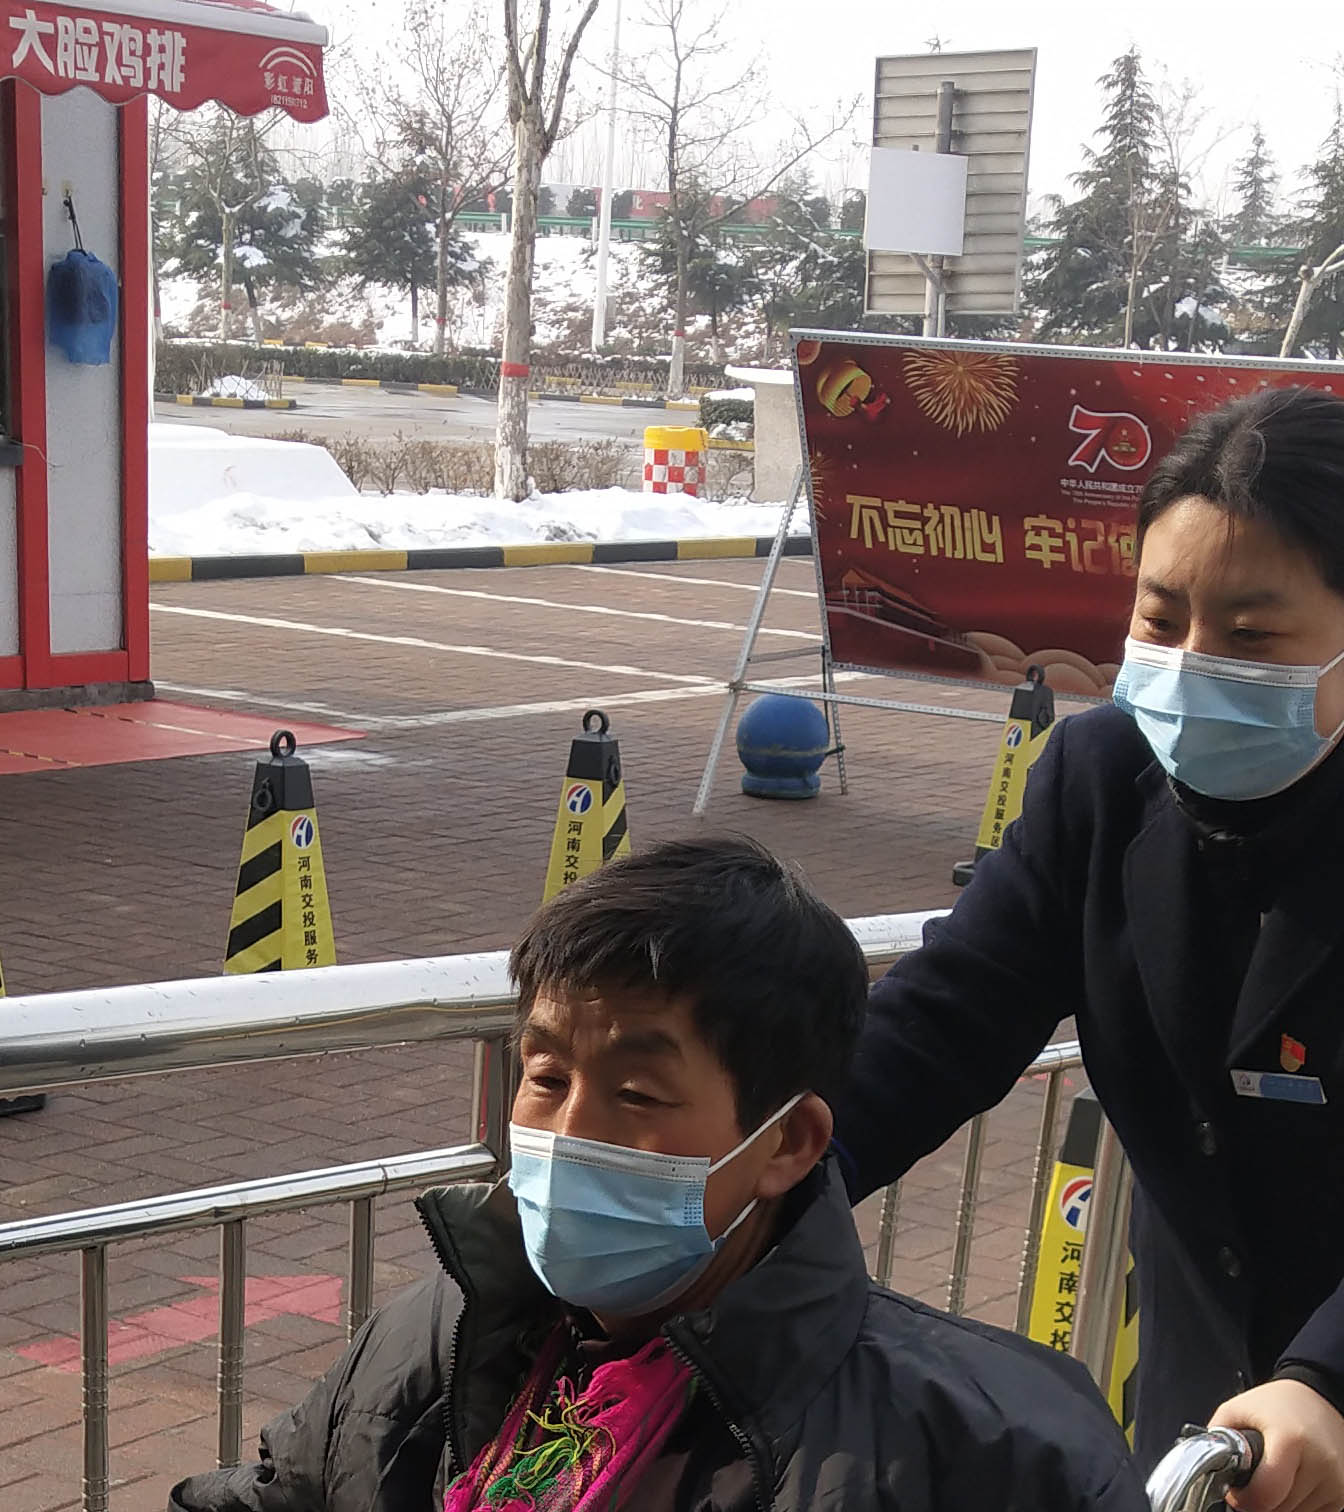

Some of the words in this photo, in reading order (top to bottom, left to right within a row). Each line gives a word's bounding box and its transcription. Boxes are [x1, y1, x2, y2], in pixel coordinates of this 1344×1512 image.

[9, 9, 187, 93] 大脸鸡排
[1067, 404, 1152, 473] 70
[846, 494, 1004, 563] 不忘初心
[991, 752, 1015, 848] 河南交投服务区
[563, 820, 583, 885] 河南交投
[297, 856, 319, 966] 河南交投服务
